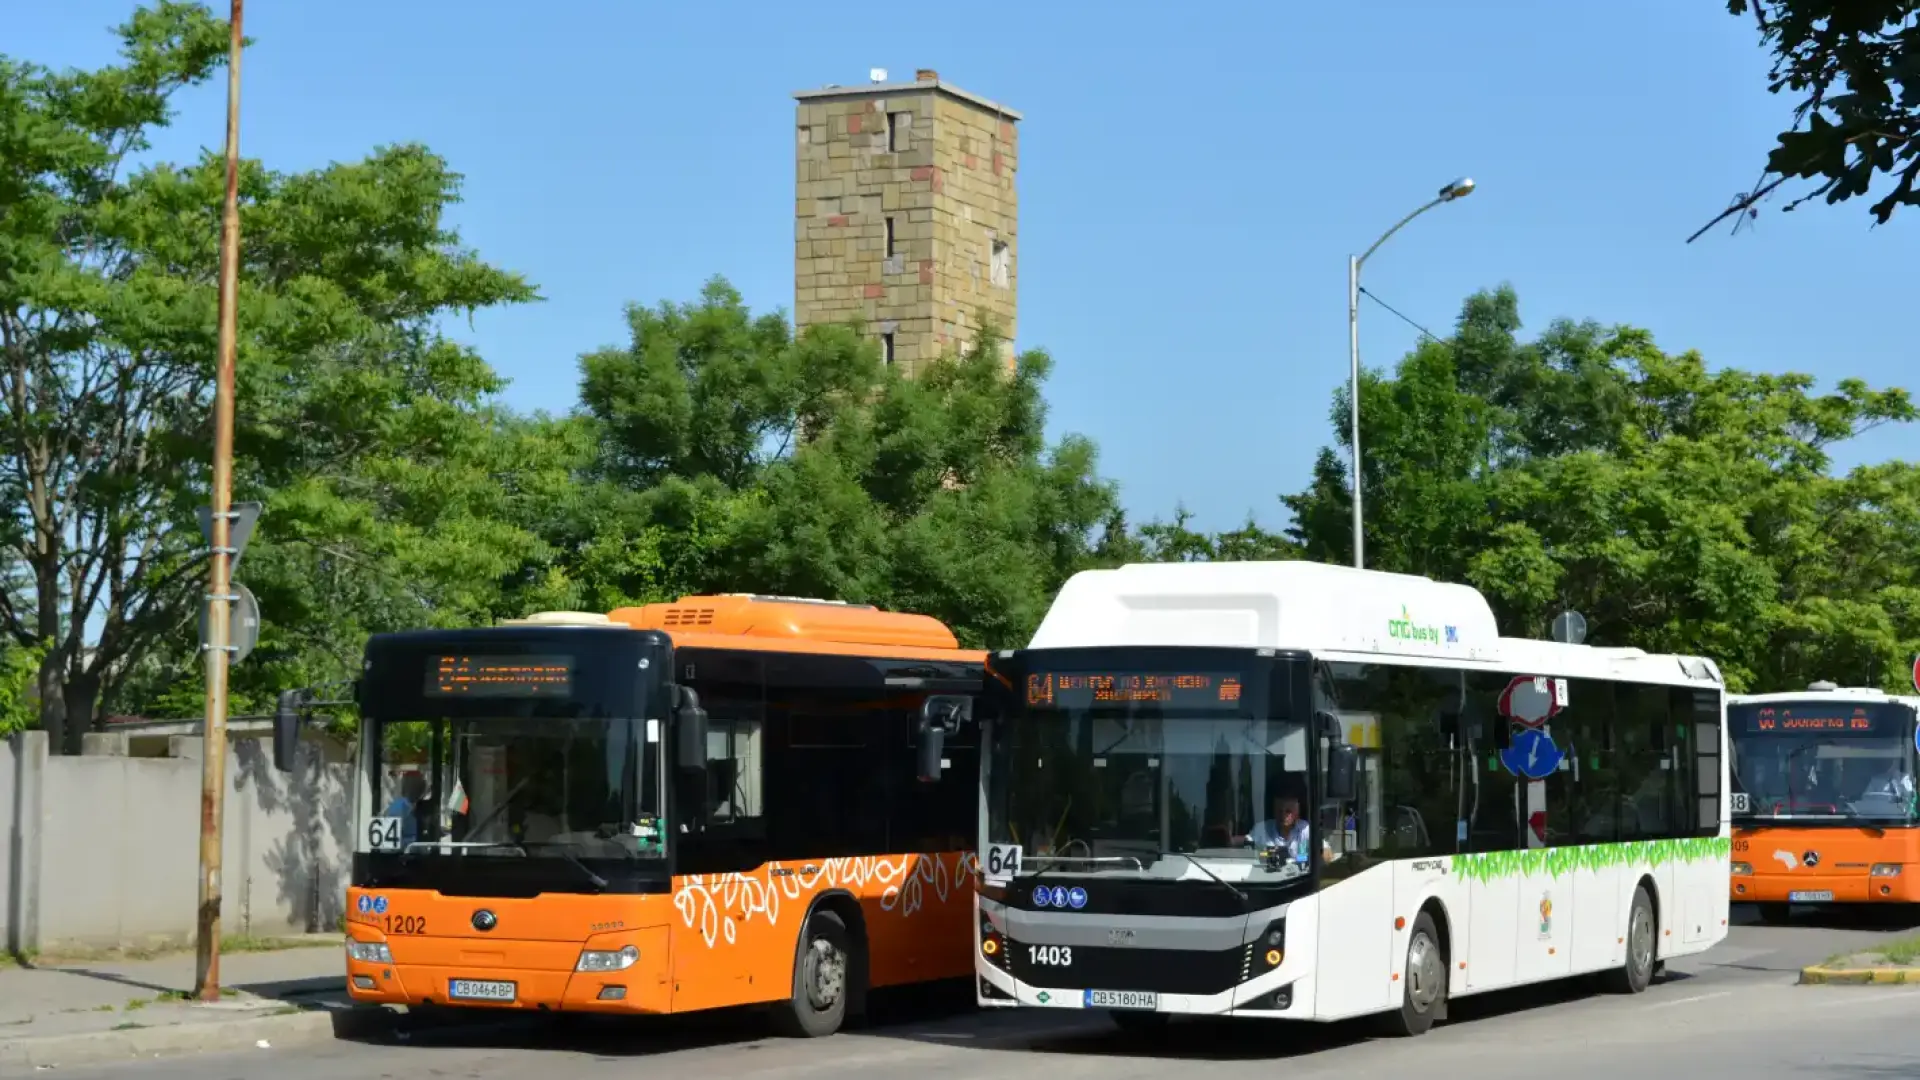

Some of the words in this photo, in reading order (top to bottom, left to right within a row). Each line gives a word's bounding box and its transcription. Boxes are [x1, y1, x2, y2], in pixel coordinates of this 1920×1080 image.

[1412, 621, 1428, 640] bus
[1428, 624, 1439, 645] by
[368, 818, 400, 849] 64
[988, 845, 1019, 877] 64
[384, 914, 427, 935] 1202
[1028, 945, 1072, 967] 1403
[1093, 991, 1107, 1004] CB
[1108, 991, 1138, 1006] 5180
[1139, 993, 1153, 1007] HA
